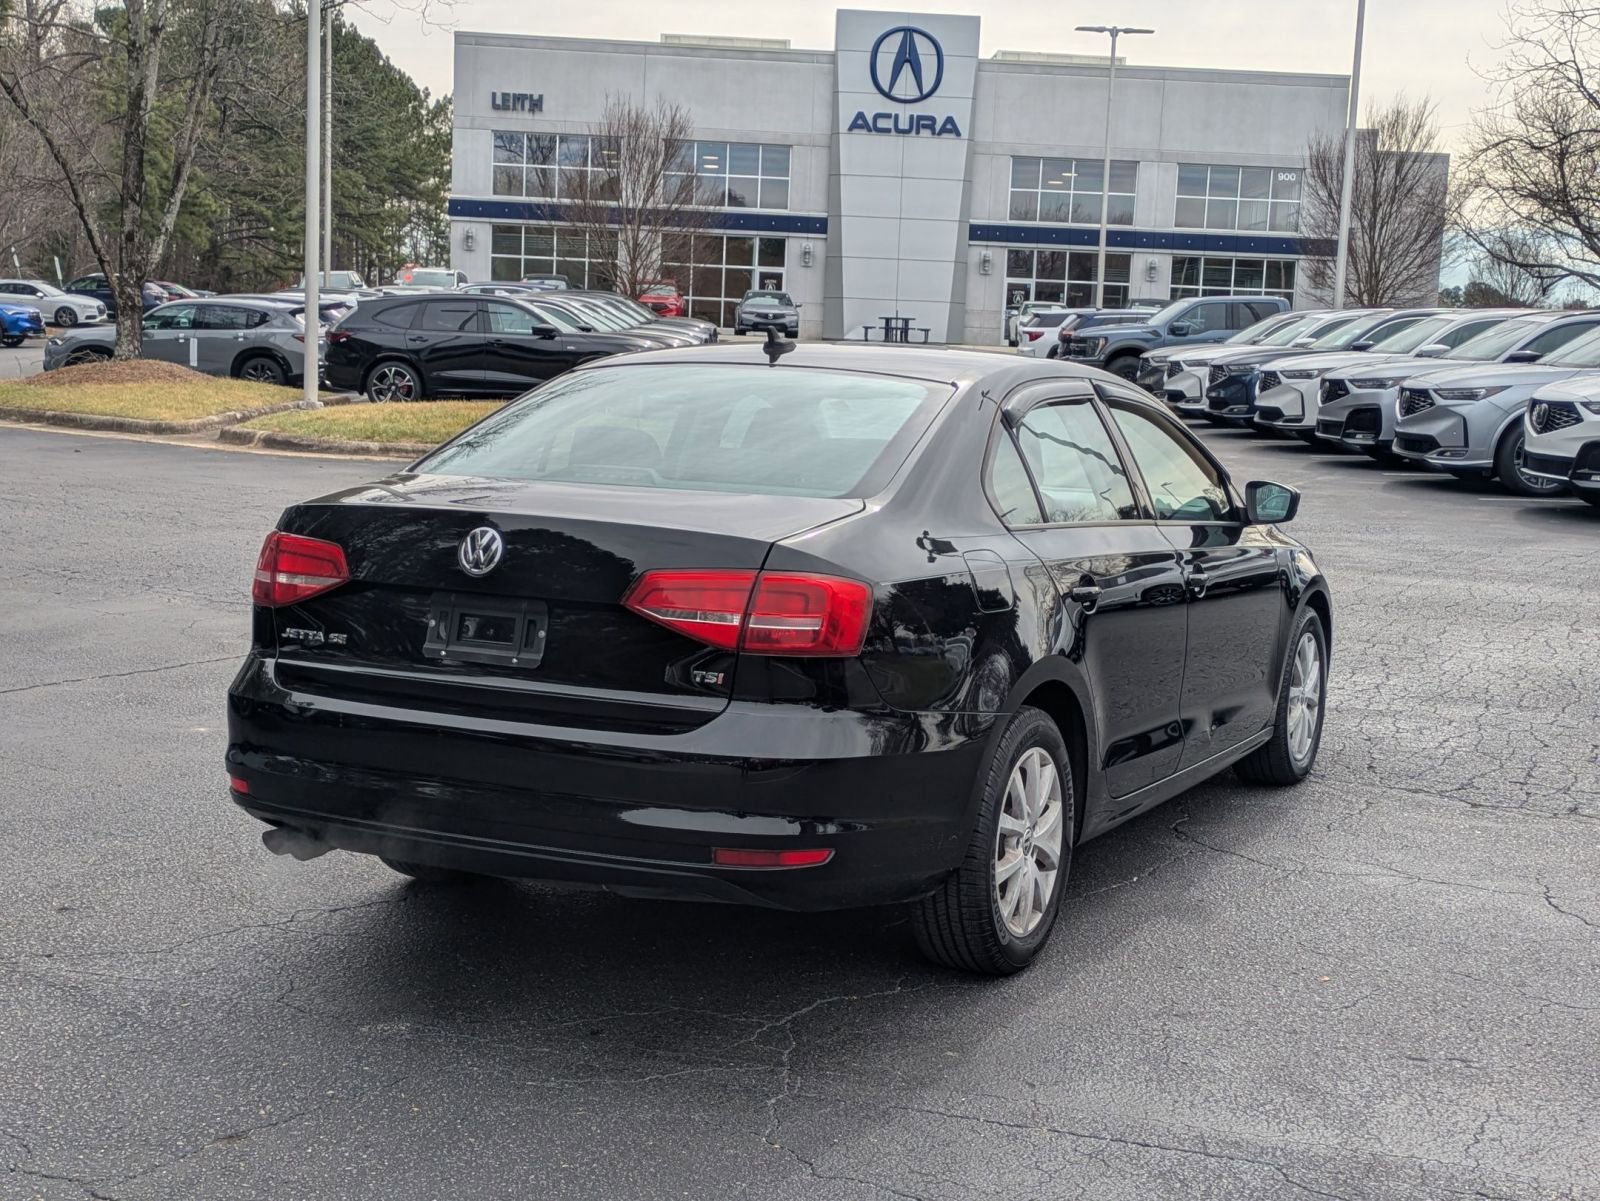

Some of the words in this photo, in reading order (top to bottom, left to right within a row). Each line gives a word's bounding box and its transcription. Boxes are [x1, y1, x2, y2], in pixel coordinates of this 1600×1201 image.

[491, 91, 544, 113] LEITH
[847, 111, 962, 137] ACURA
[1277, 172, 1296, 181] 900
[460, 526, 503, 575] VW
[281, 627, 325, 643] JETTA
[327, 632, 348, 645] SE
